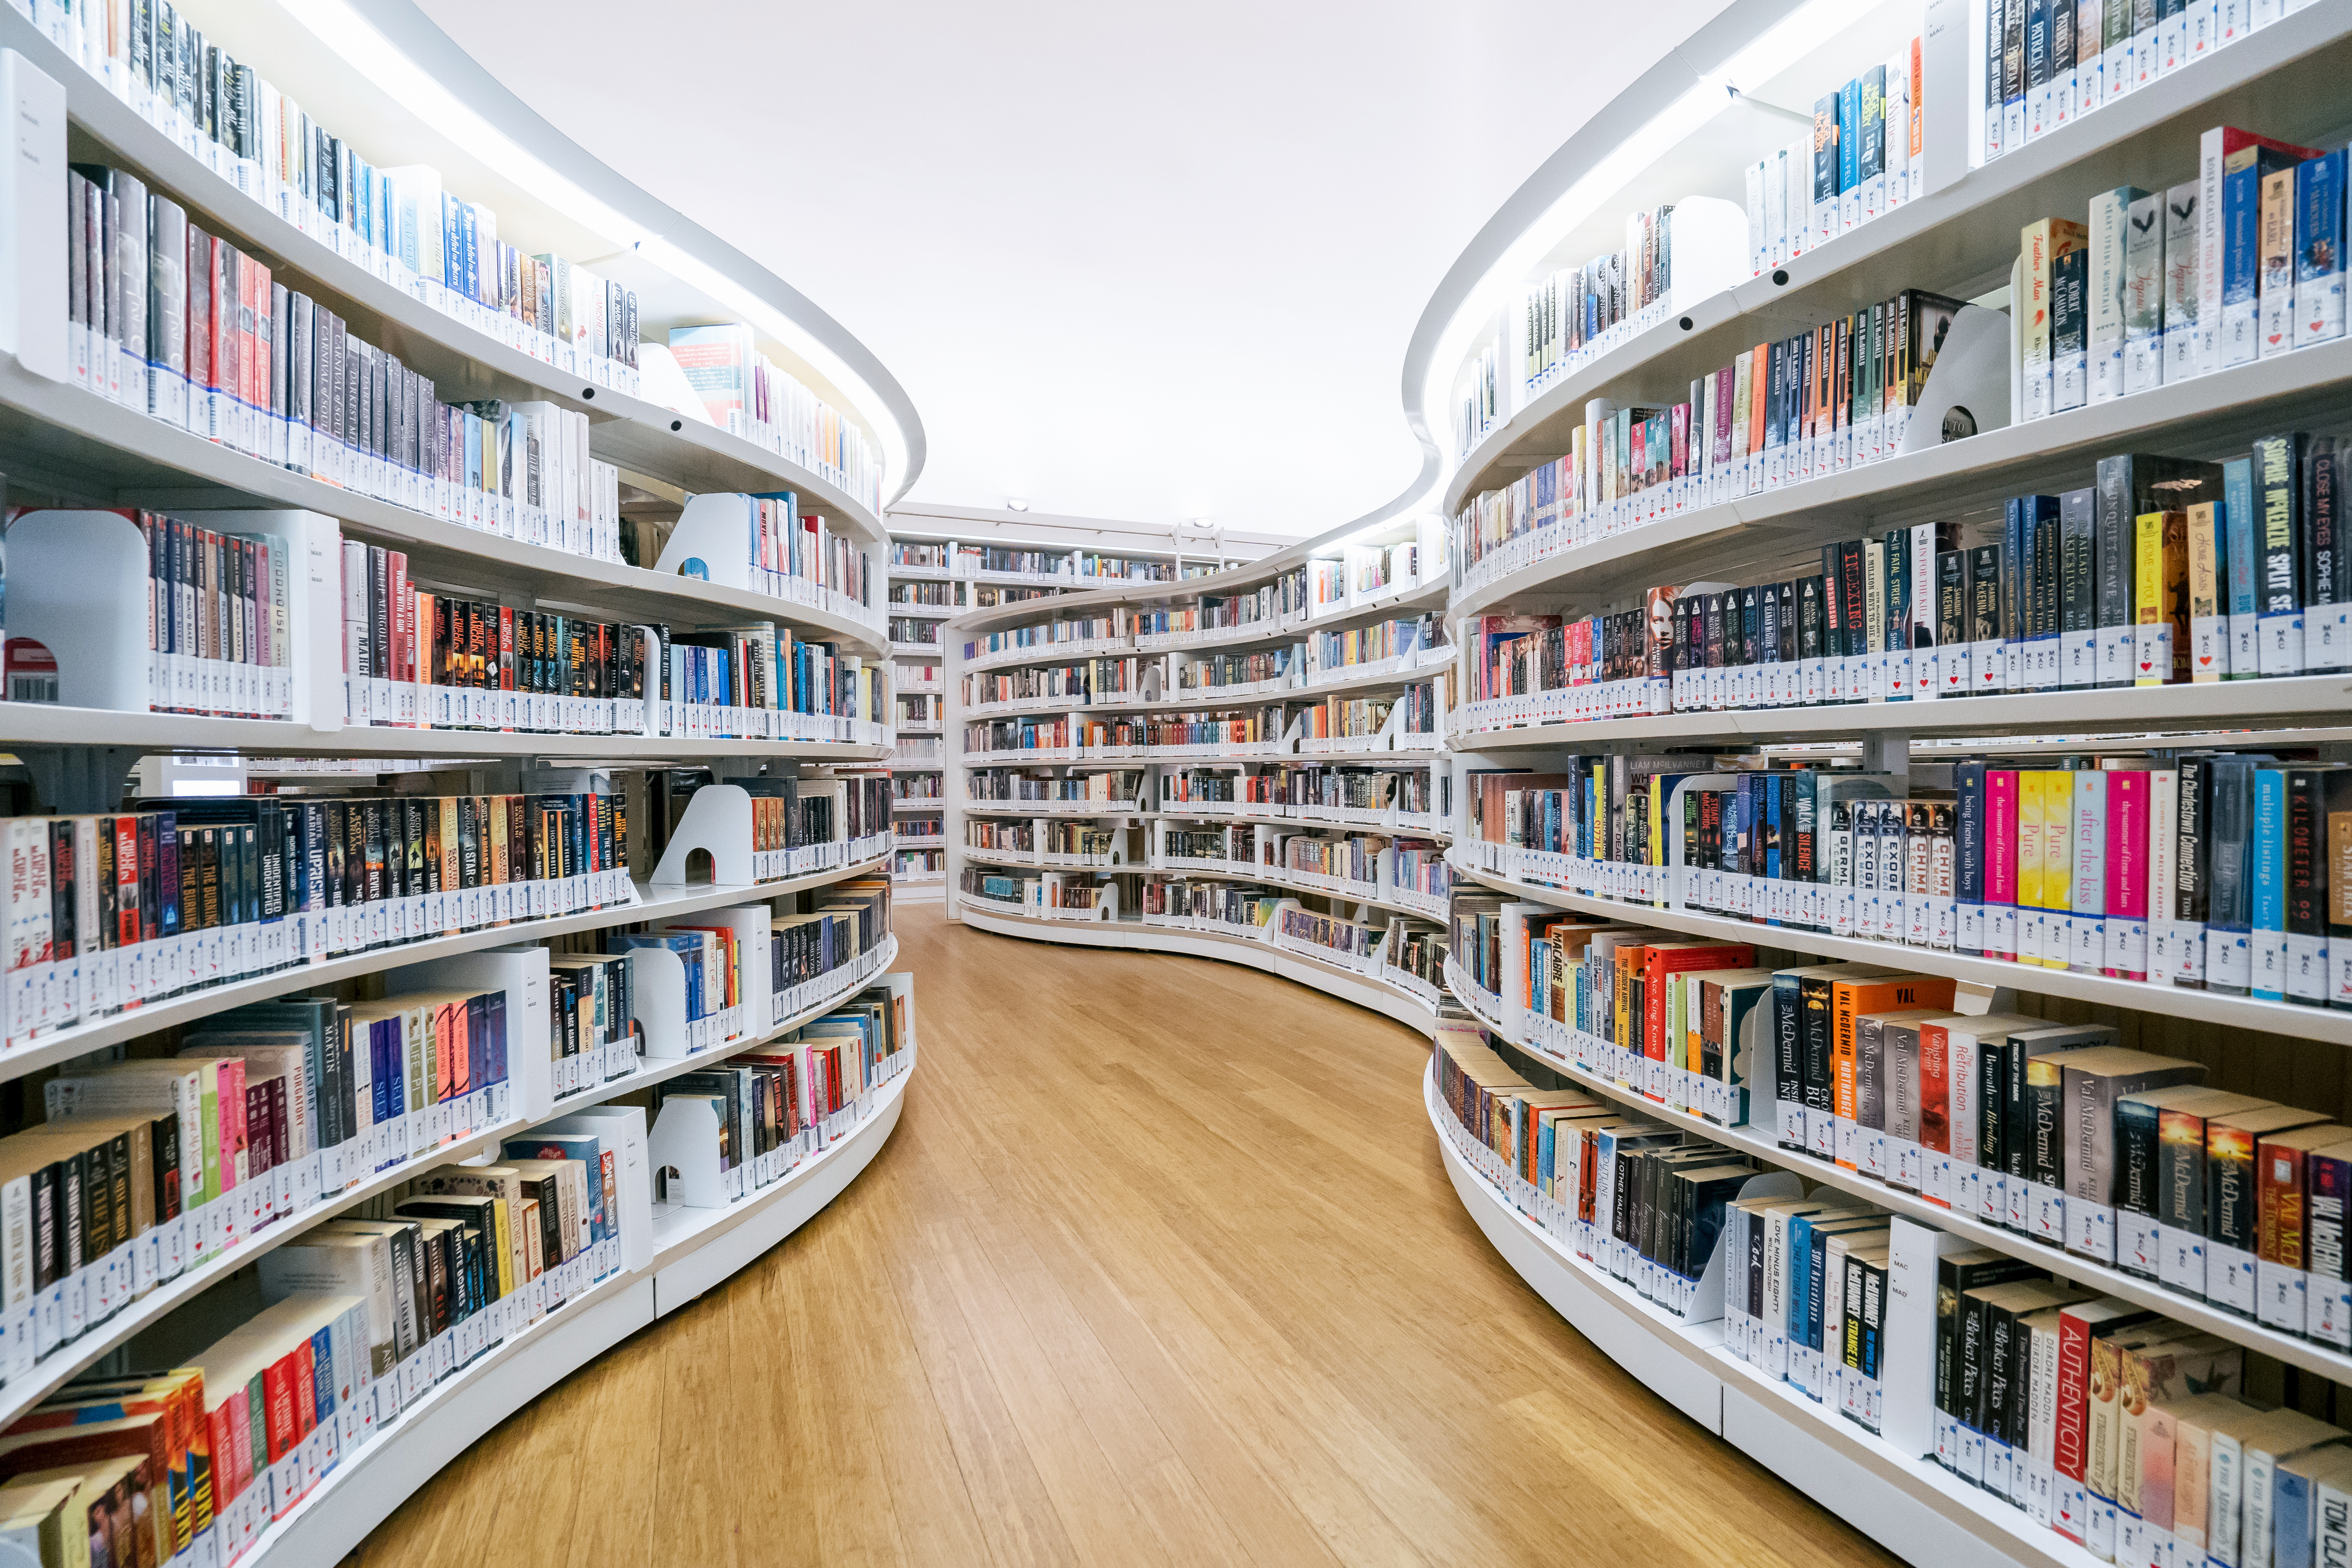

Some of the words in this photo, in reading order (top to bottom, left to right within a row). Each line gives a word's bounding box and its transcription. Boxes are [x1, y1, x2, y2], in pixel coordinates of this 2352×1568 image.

[1870, 85, 1879, 118] NIGEL
[2034, 234, 2043, 271] Feather
[2034, 278, 2044, 300] Man
[2067, 280, 2080, 312] ROBERT
[596, 295, 604, 337] VANISHED
[614, 303, 622, 338] MARKLUND
[2264, 439, 2288, 485] SOPHIE
[2317, 459, 2330, 494] CLOSE
[2317, 496, 2330, 510] MY
[2317, 512, 2331, 546] EYES
[1890, 552, 1900, 577] FATAL
[1919, 548, 1927, 557] IN
[2268, 553, 2291, 590] SPLIT
[2317, 551, 2331, 590] SOPHIE
[1845, 552, 1861, 629] INDEXING
[1890, 578, 1900, 607] STRIKE
[1919, 596, 1927, 618] KILL
[378, 598, 388, 652] MARGOLIN
[1631, 761, 1650, 770] LIAM
[2183, 764, 2197, 779] The
[1799, 798, 1811, 824] WALK
[1966, 796, 1975, 818] being
[2181, 779, 2197, 833] Charlestown
[1966, 819, 1975, 847] friends
[2024, 824, 2039, 857] Pure
[2050, 825, 2066, 858] Pure
[2082, 809, 2099, 842] after
[2294, 795, 2309, 889] KILOMETER
[1799, 833, 1811, 871] SILENCE
[1966, 850, 1975, 869] with
[2081, 844, 2098, 872] the
[2179, 834, 2198, 892] Connection
[263, 855, 272, 915] UNIDENTIFIED
[272, 854, 281, 913] UNIDENTIFIED
[309, 849, 324, 911] UPRISING
[1964, 871, 1974, 891] boys
[2080, 877, 2097, 906] kiss
[1552, 932, 1563, 983] MACABRE
[1781, 1005, 1793, 1013] Val
[1840, 991, 1850, 1007] VAL
[1897, 988, 1915, 1004] VAL
[1781, 1011, 1796, 1074] McDermid
[1865, 1022, 1875, 1040] Val
[1898, 1035, 1907, 1056] Val
[325, 1026, 334, 1074] MARTIN
[410, 1039, 420, 1070] LIFE
[1809, 1019, 1823, 1082] McDermid
[411, 1078, 422, 1095] PI
[1863, 1042, 1876, 1099] McDermid
[1898, 1058, 1908, 1117] McDermid
[1955, 1046, 1966, 1112] Retribution
[295, 1066, 304, 1126] PURGATORY
[376, 1081, 384, 1125] SELF
[392, 1076, 401, 1115] SELF
[1841, 1061, 1852, 1119] NORTHANGER
[2082, 1080, 2095, 1104] Val
[2038, 1096, 2054, 1169] McDermid
[2082, 1106, 2095, 1174] McDermid
[2175, 1152, 2191, 1219] McDermid
[2221, 1161, 2239, 1235] McDermid
[512, 1201, 522, 1244] VISITORS
[1616, 1221, 1621, 1233] ME
[1813, 1250, 1821, 1269] SOFT
[1894, 1260, 1908, 1270] MAC
[457, 1268, 465, 1307] BONES
[1810, 1269, 1821, 1322] Apocalypse
[1892, 1287, 1907, 1298] MAD
[1848, 1319, 1858, 1354] STRANGE
[2045, 1338, 2055, 1381] DEIRDRE
[2043, 1382, 2052, 1426] MADDEN
[2060, 1325, 2083, 1478] AUTHENTICITY
